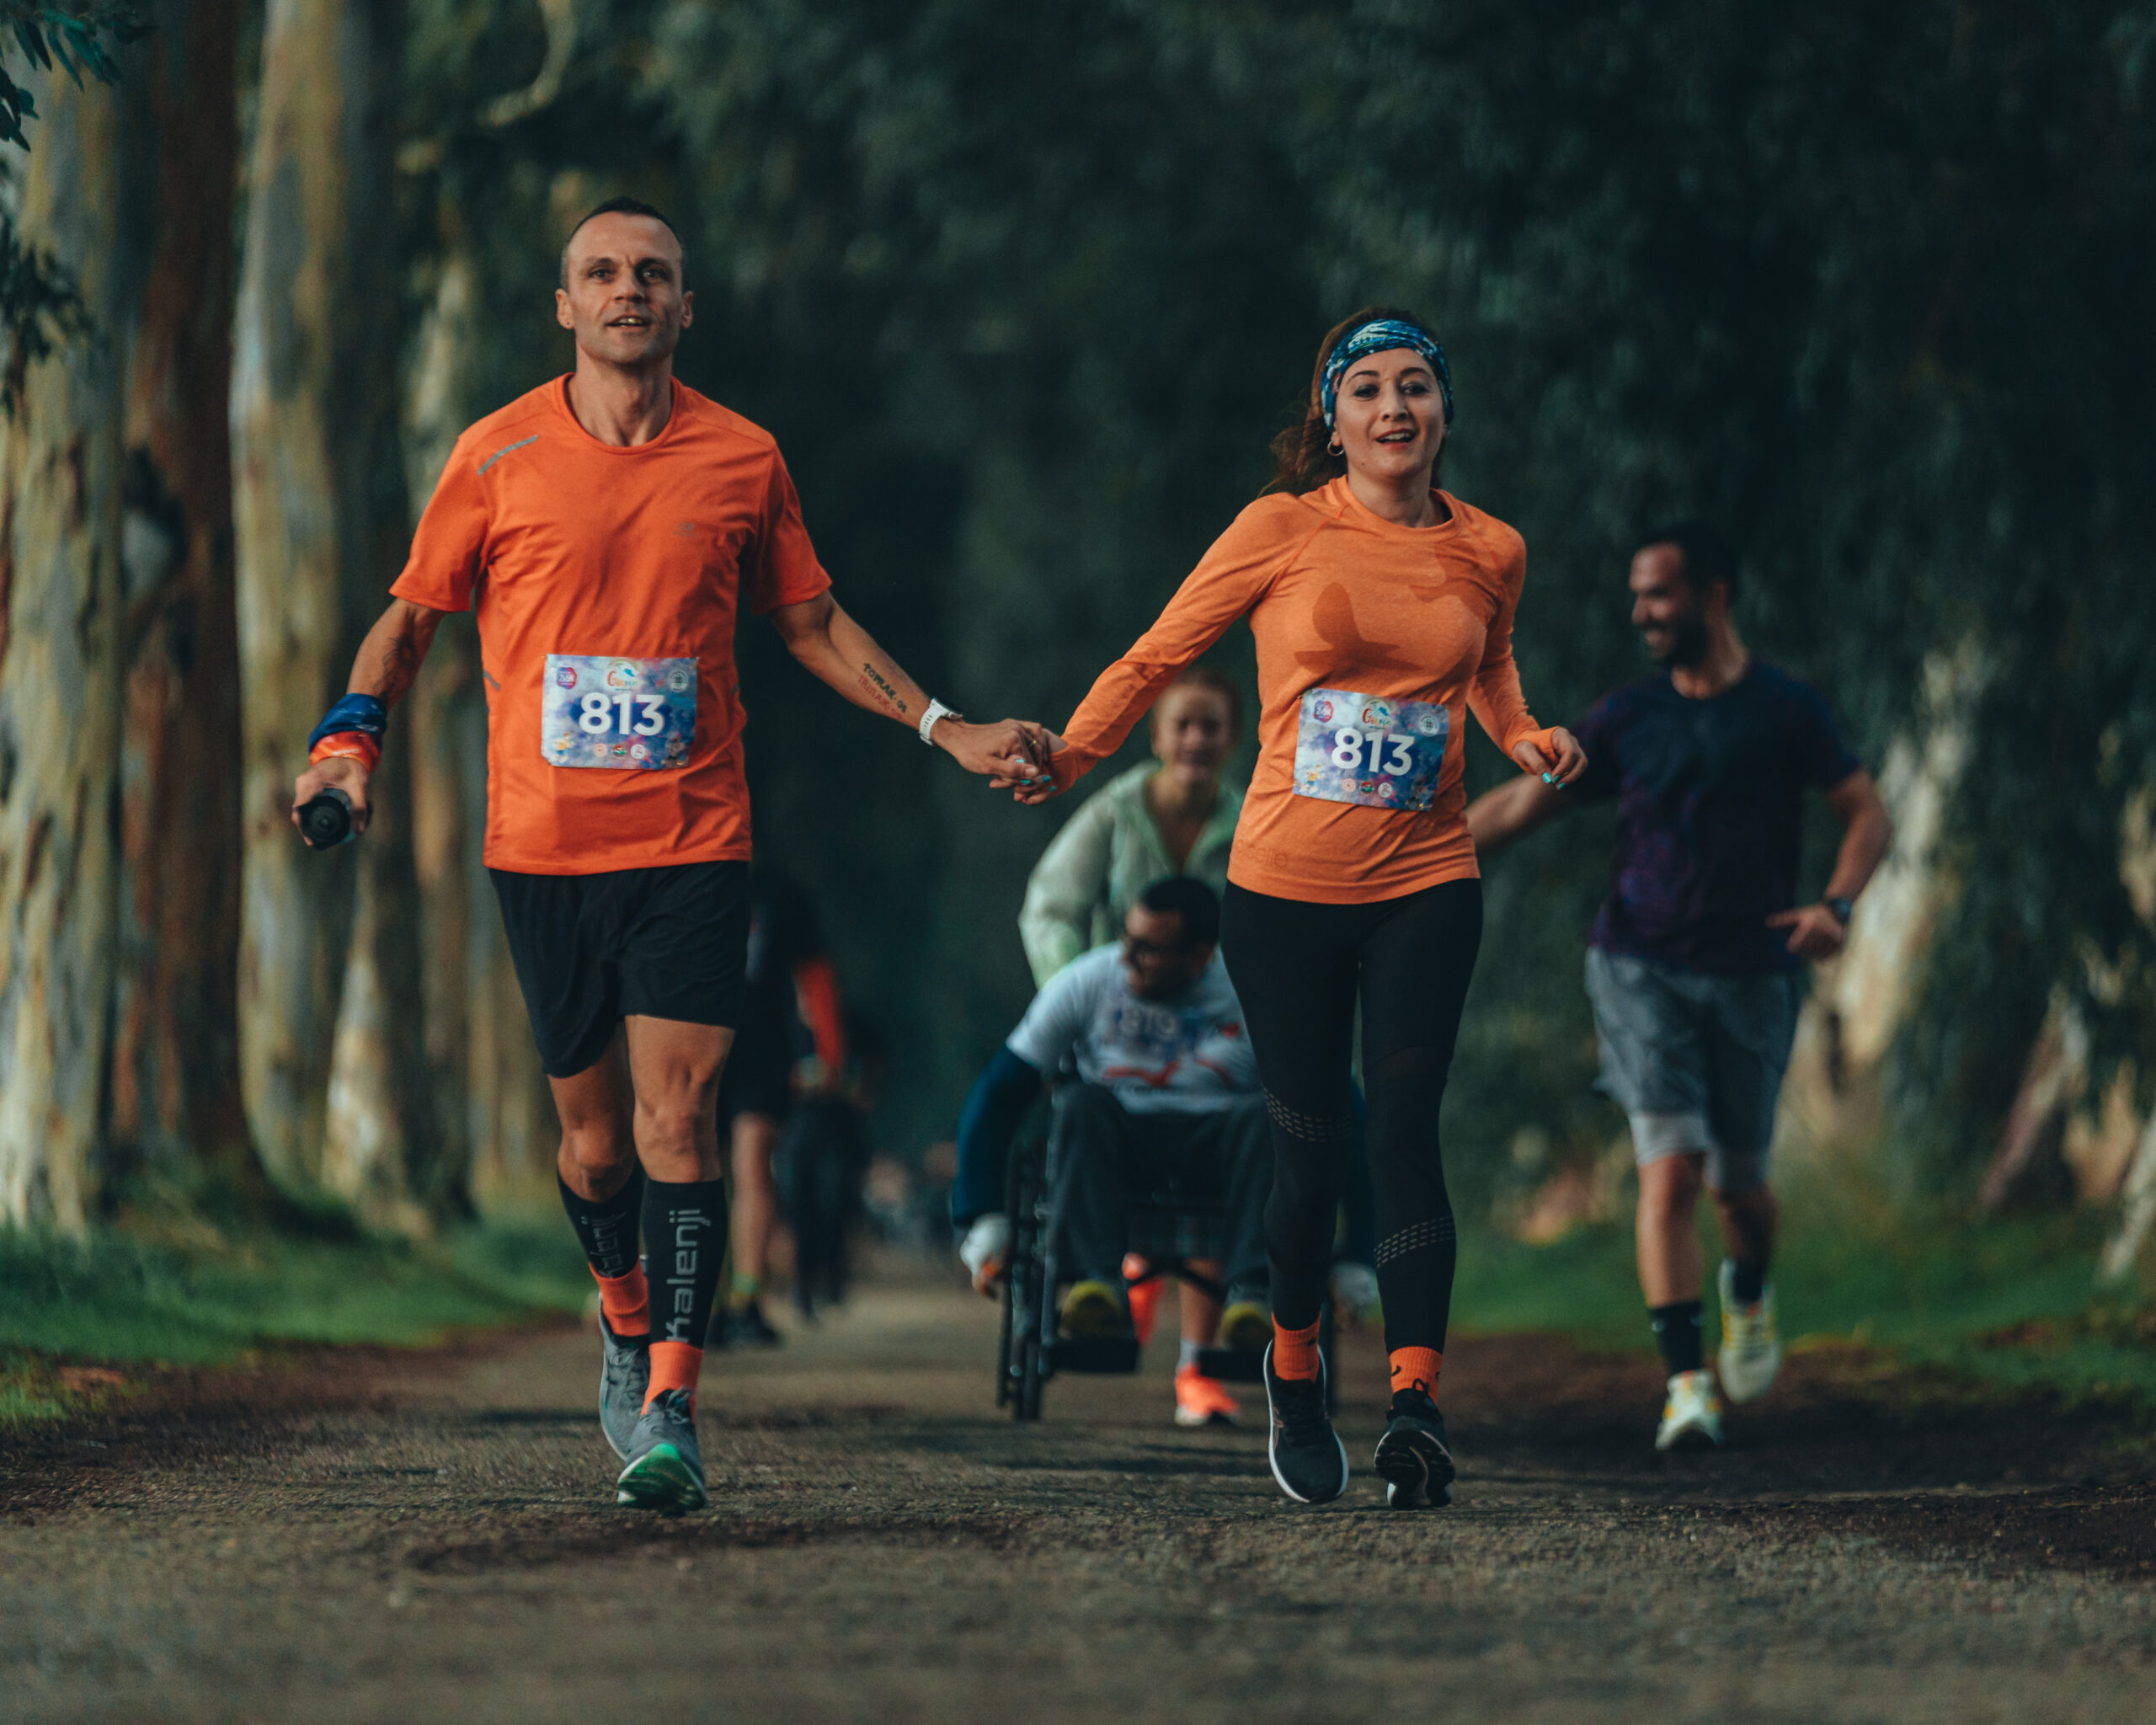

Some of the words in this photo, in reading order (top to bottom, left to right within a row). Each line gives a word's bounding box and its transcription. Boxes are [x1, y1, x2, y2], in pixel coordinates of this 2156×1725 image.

[579, 692, 664, 735] 813
[1331, 728, 1415, 776] 813
[666, 1210, 711, 1343] kalenji
